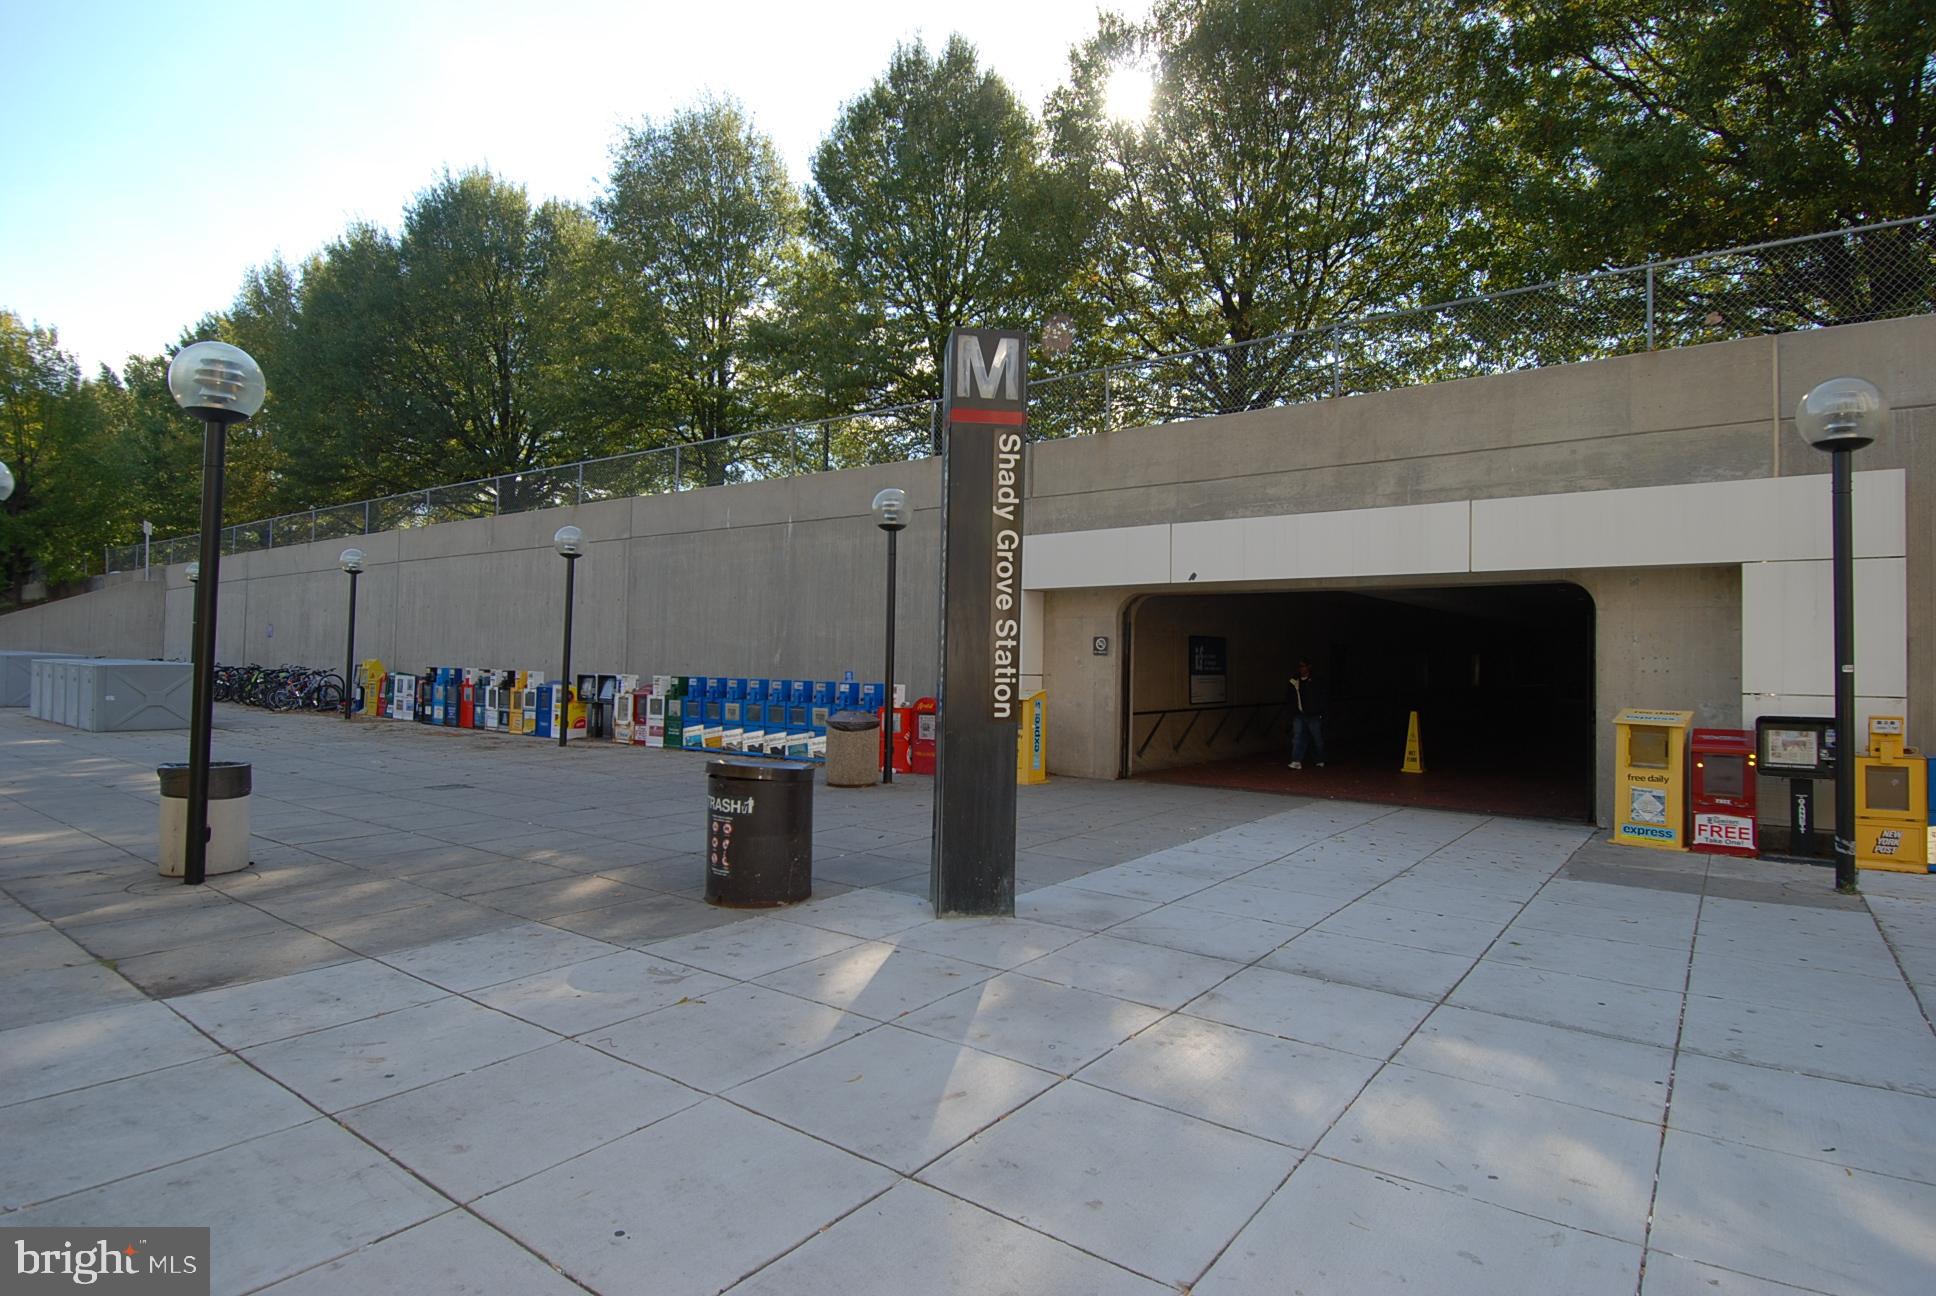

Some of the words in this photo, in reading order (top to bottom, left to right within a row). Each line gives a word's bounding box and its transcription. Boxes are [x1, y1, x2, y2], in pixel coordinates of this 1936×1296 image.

[957, 335, 1020, 400] M
[993, 433, 1021, 521] Shady
[995, 529, 1020, 611] Grove
[994, 618, 1018, 719] Station
[1627, 773, 1647, 783] free
[1648, 774, 1670, 785] daily
[1622, 824, 1673, 839] express
[1698, 823, 1751, 840] FREE
